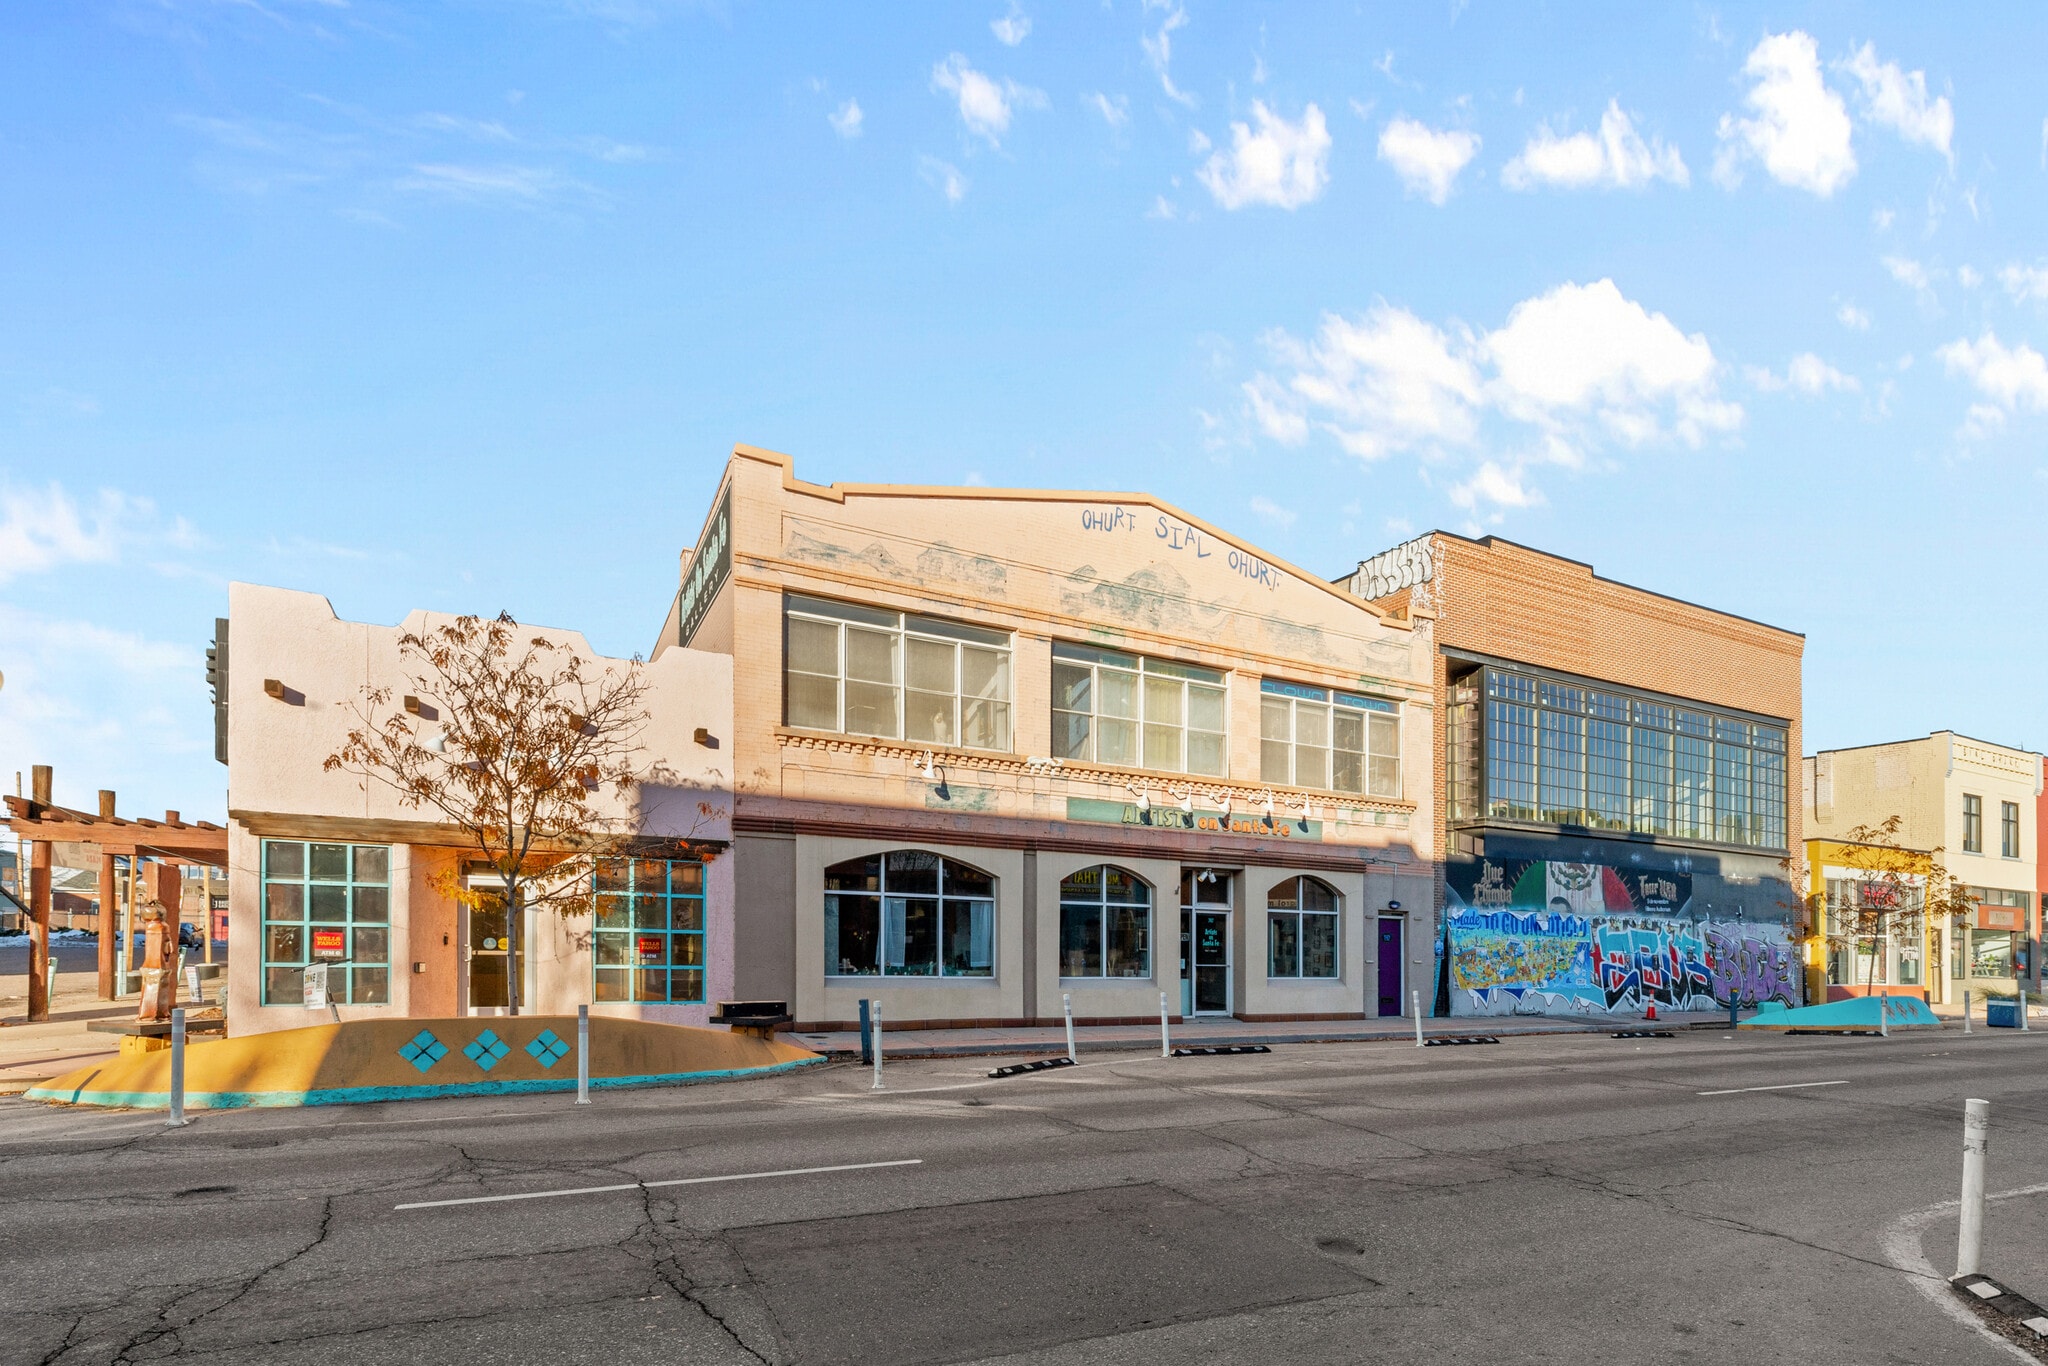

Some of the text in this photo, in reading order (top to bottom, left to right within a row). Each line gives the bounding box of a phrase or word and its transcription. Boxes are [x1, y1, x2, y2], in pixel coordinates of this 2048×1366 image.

[1155, 516, 1212, 558] SIAL
[685, 568, 720, 637] GALLERY
[1261, 682, 1389, 711] CLOWN TOWN
[1198, 816, 1219, 831] on
[1271, 819, 1291, 837] Fe
[1638, 874, 1659, 899] Tour
